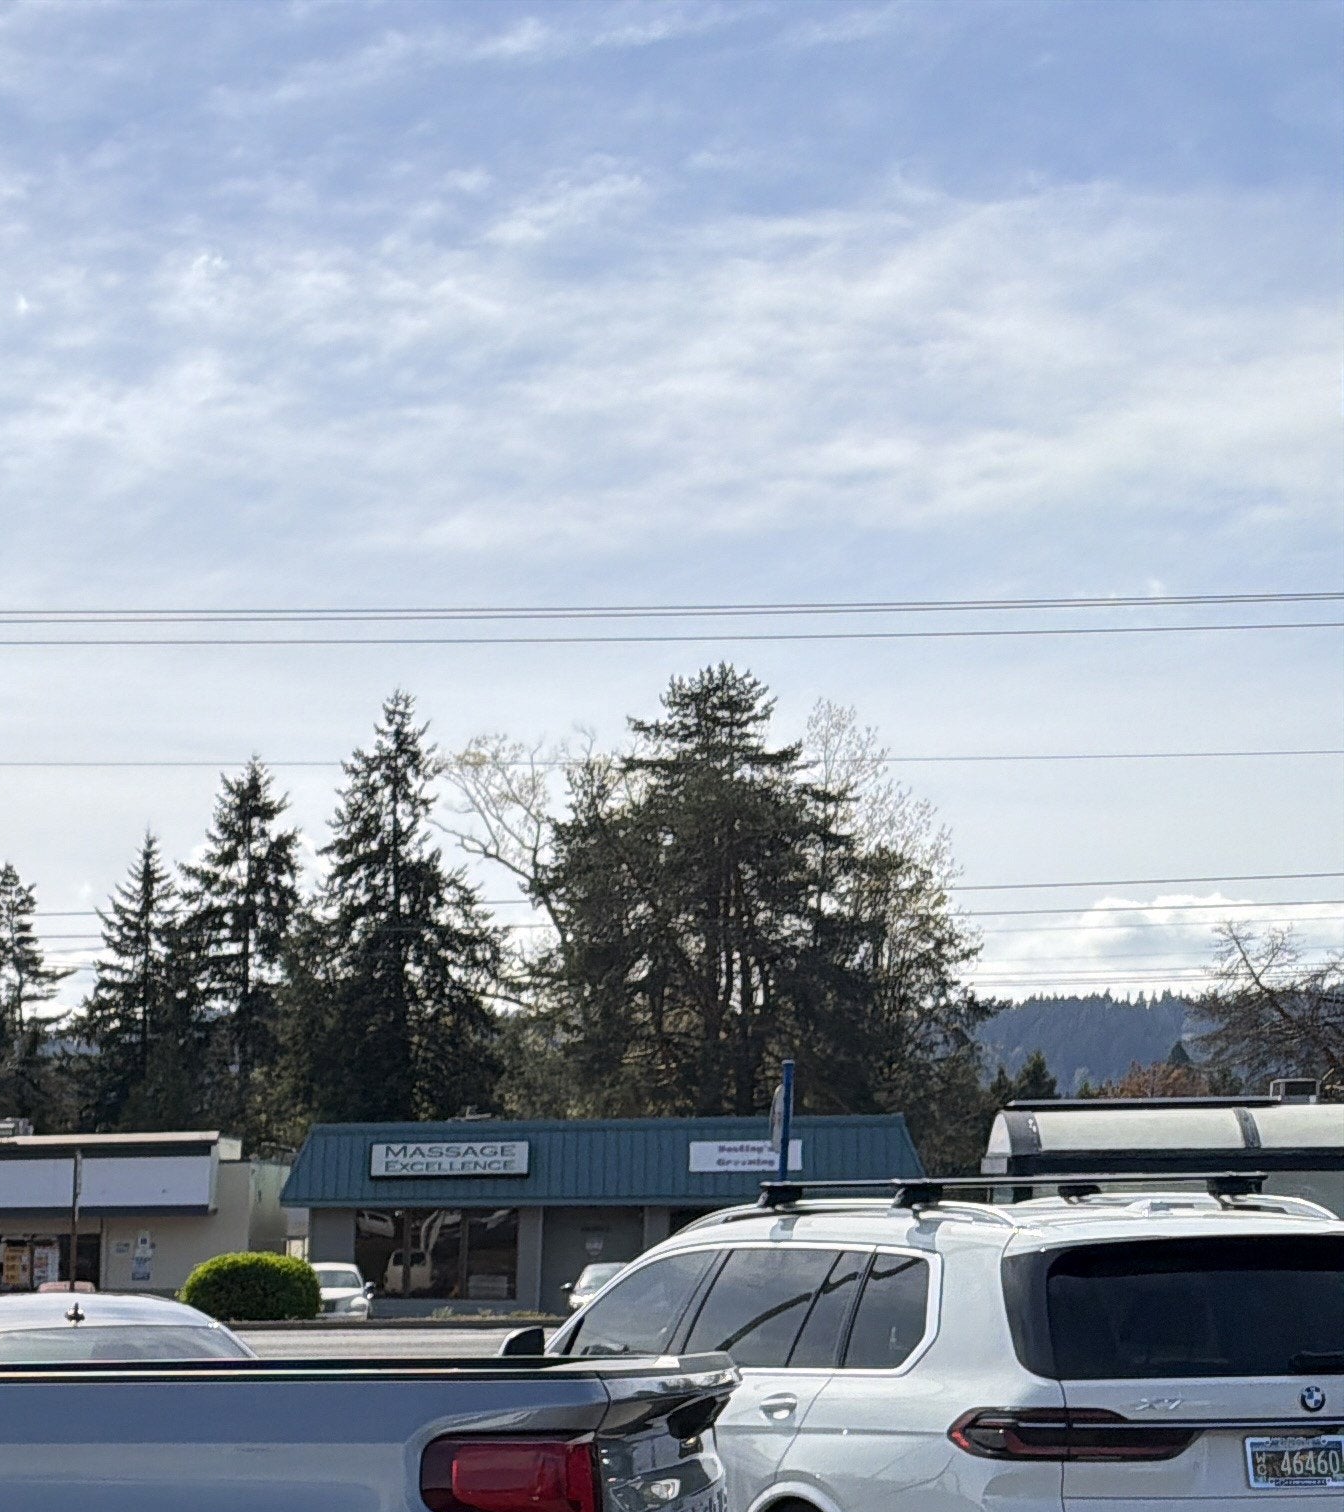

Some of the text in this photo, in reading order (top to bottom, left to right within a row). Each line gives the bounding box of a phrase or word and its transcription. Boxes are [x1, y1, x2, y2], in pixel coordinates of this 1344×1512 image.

[385, 1145, 516, 1159] MASSAGE
[384, 1160, 516, 1173] EXCELLENCE
[1280, 1450, 1340, 1477] 46460
